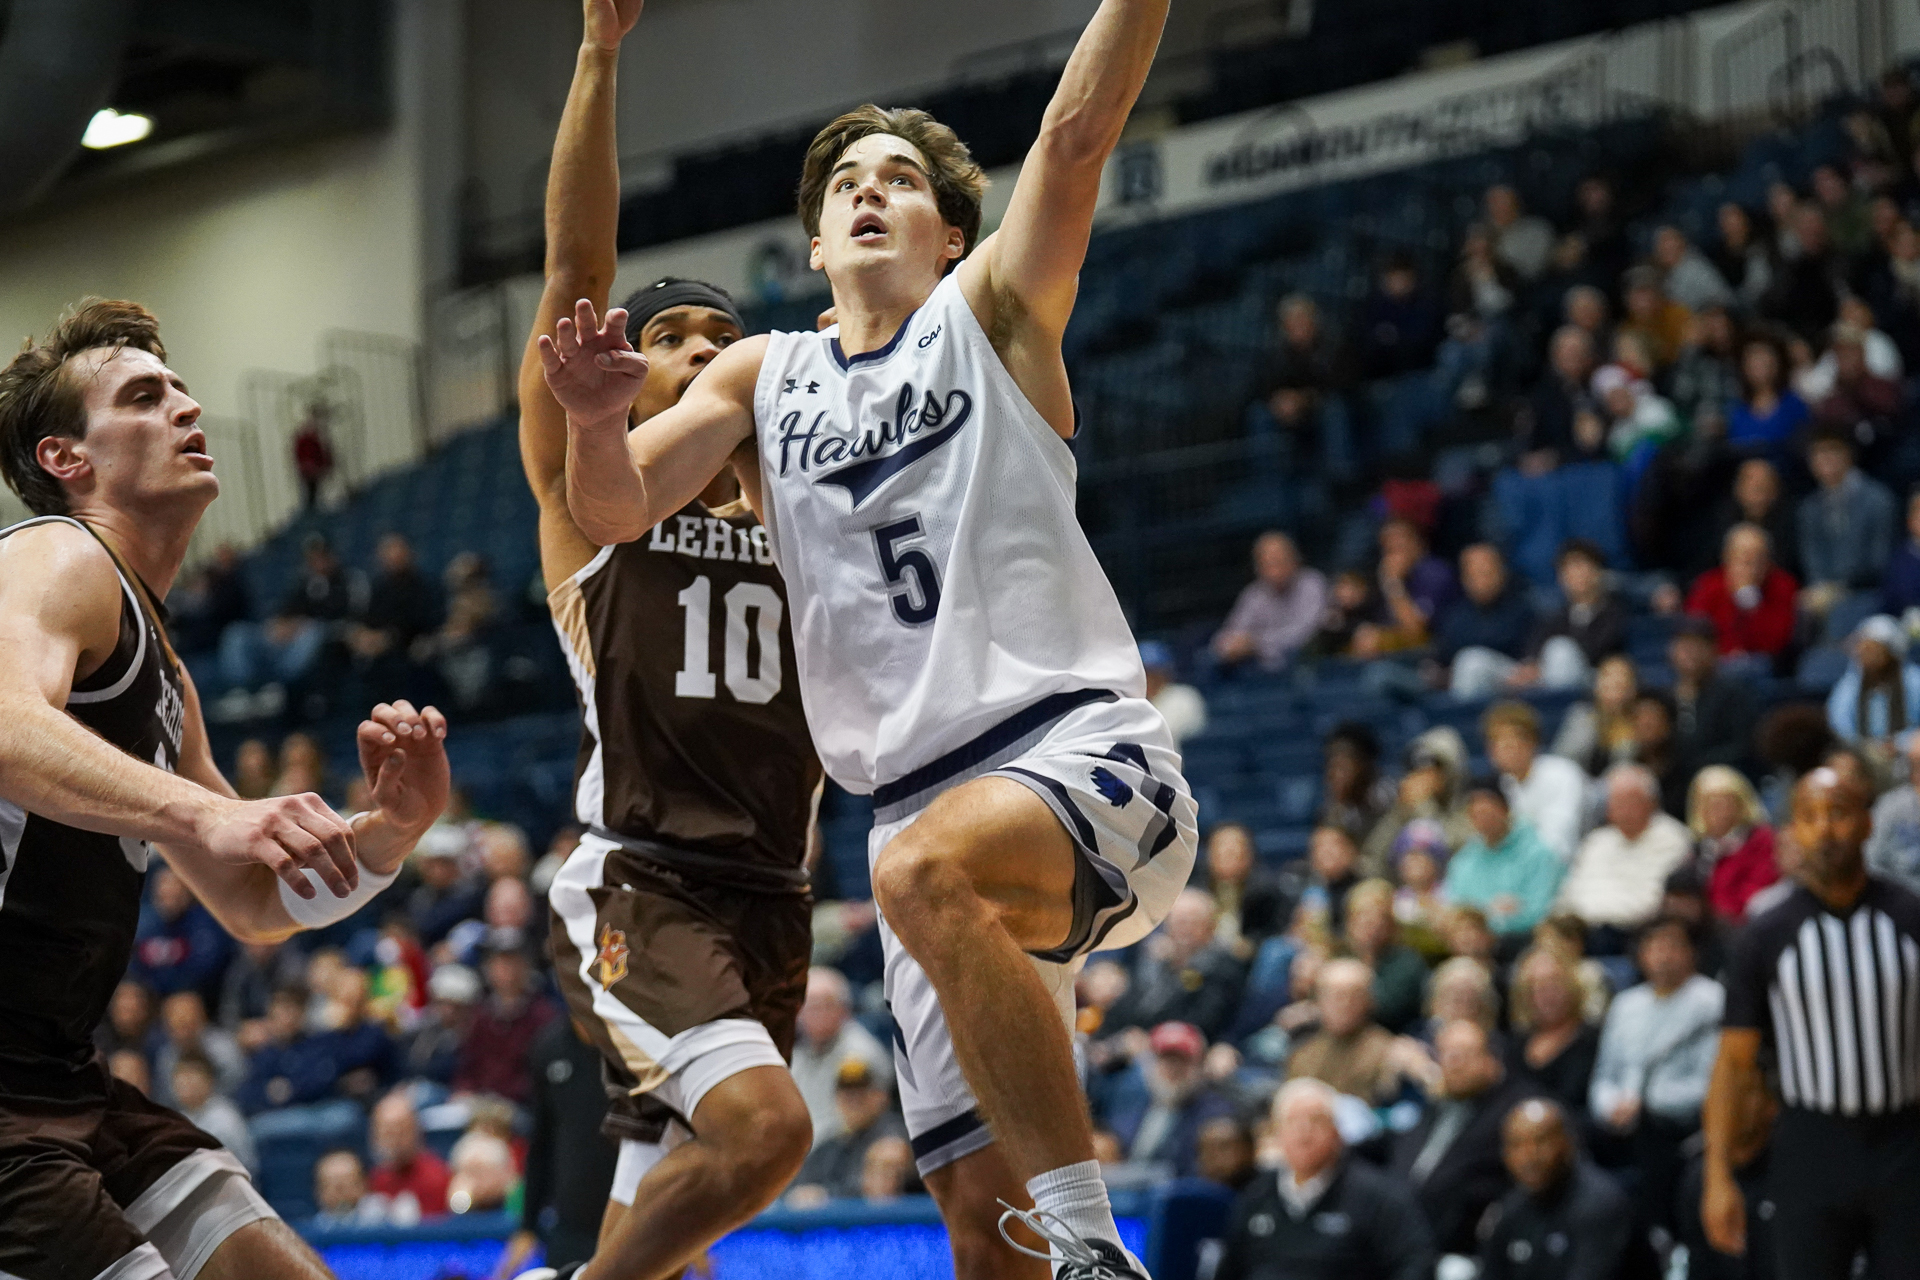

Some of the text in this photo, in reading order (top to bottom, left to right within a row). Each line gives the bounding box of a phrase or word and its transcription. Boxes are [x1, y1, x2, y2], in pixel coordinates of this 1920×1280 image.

[918, 324, 942, 348] CAA
[779, 381, 973, 479] Hawks
[649, 514, 775, 567] LEHIG
[869, 511, 945, 629] 5
[675, 575, 783, 705] 10
